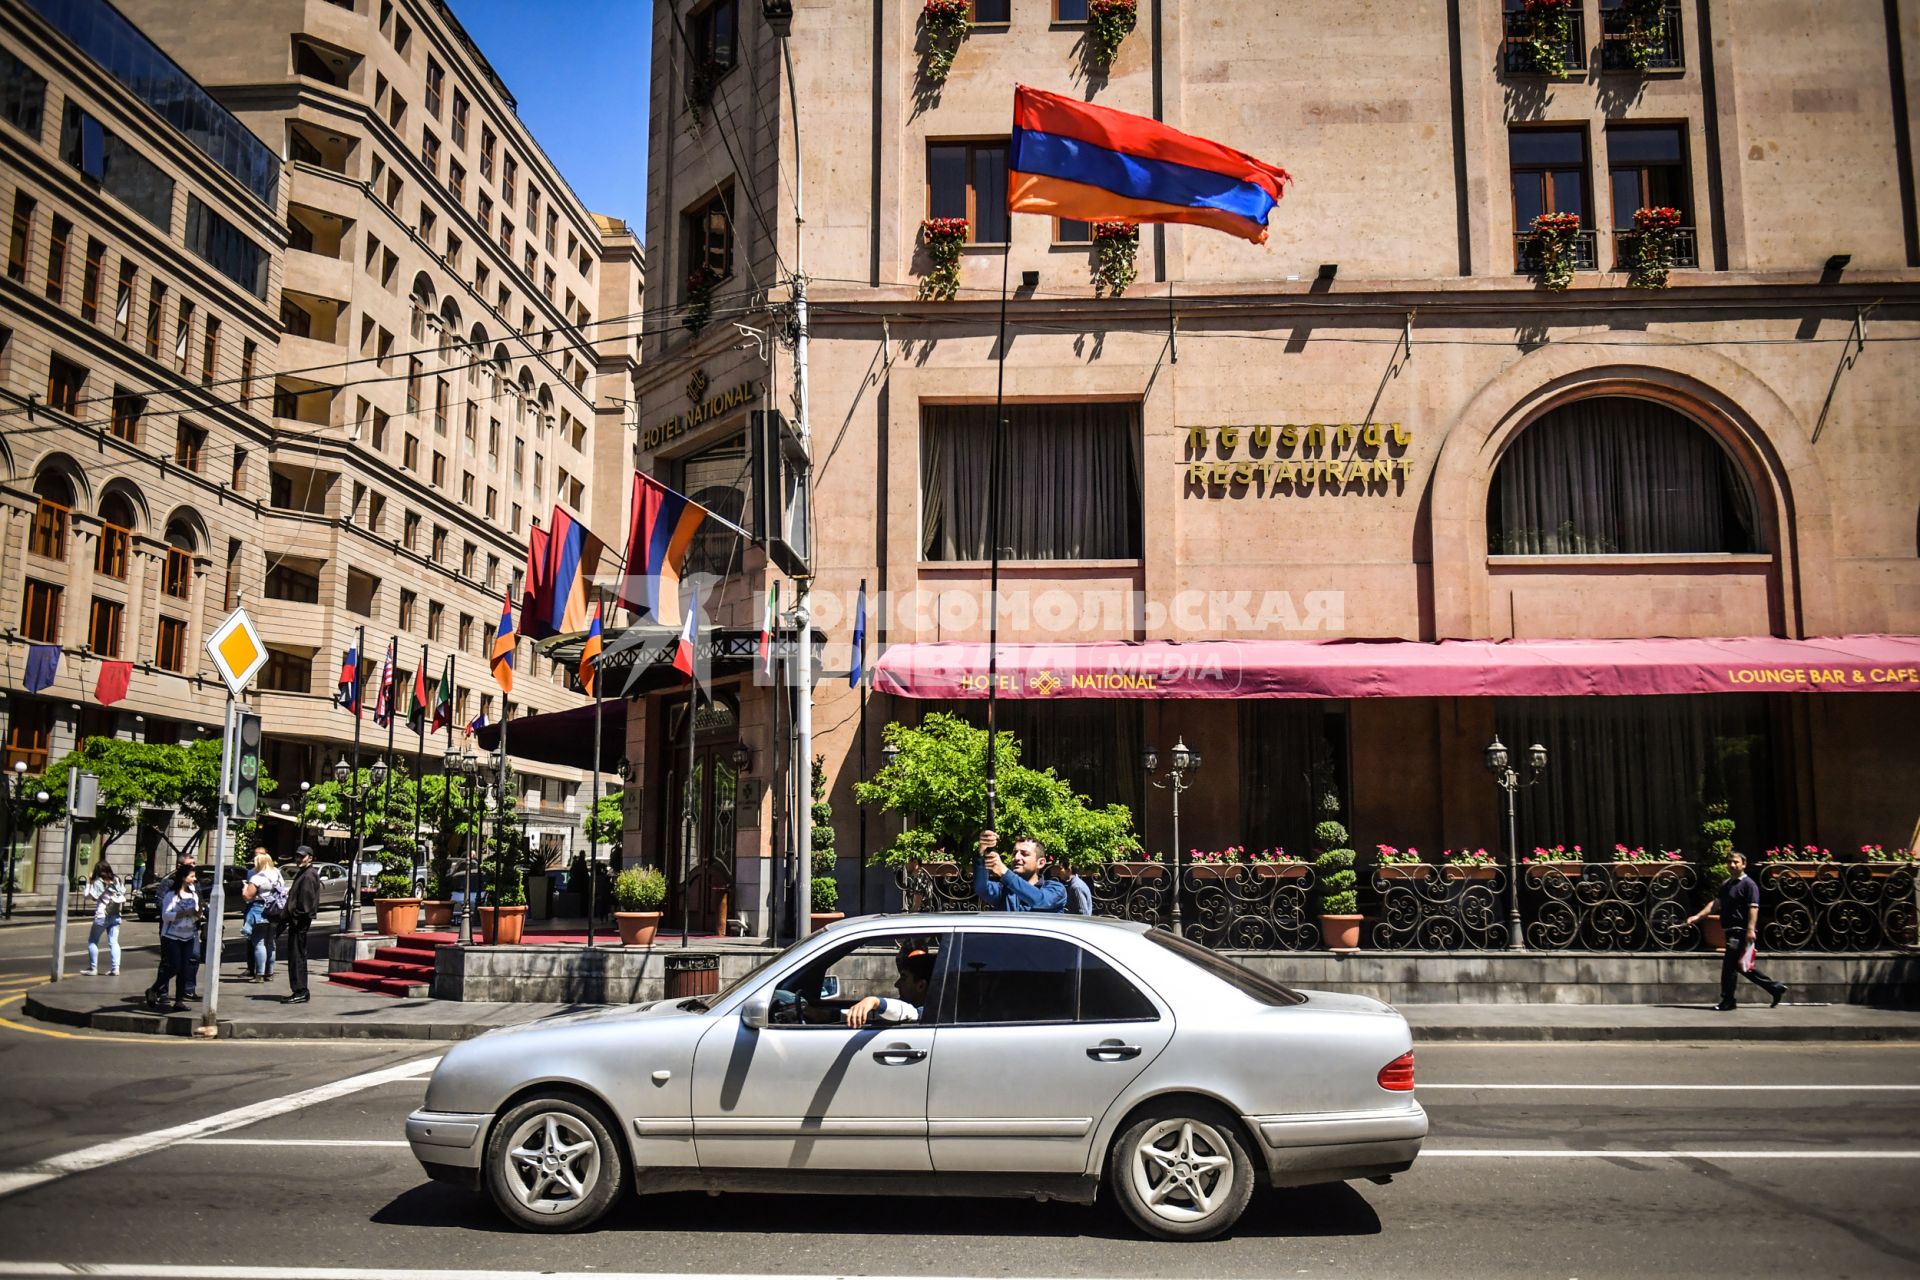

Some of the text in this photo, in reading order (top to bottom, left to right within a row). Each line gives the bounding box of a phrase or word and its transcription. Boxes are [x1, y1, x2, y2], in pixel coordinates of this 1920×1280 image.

[643, 381, 753, 449] HOTEL NATIONAL
[1189, 459, 1413, 484] RESTAURANT
[961, 674, 1157, 691] HOTEL NATIONAL
[1728, 668, 1919, 683] LOUNGE BAR & CAFE
